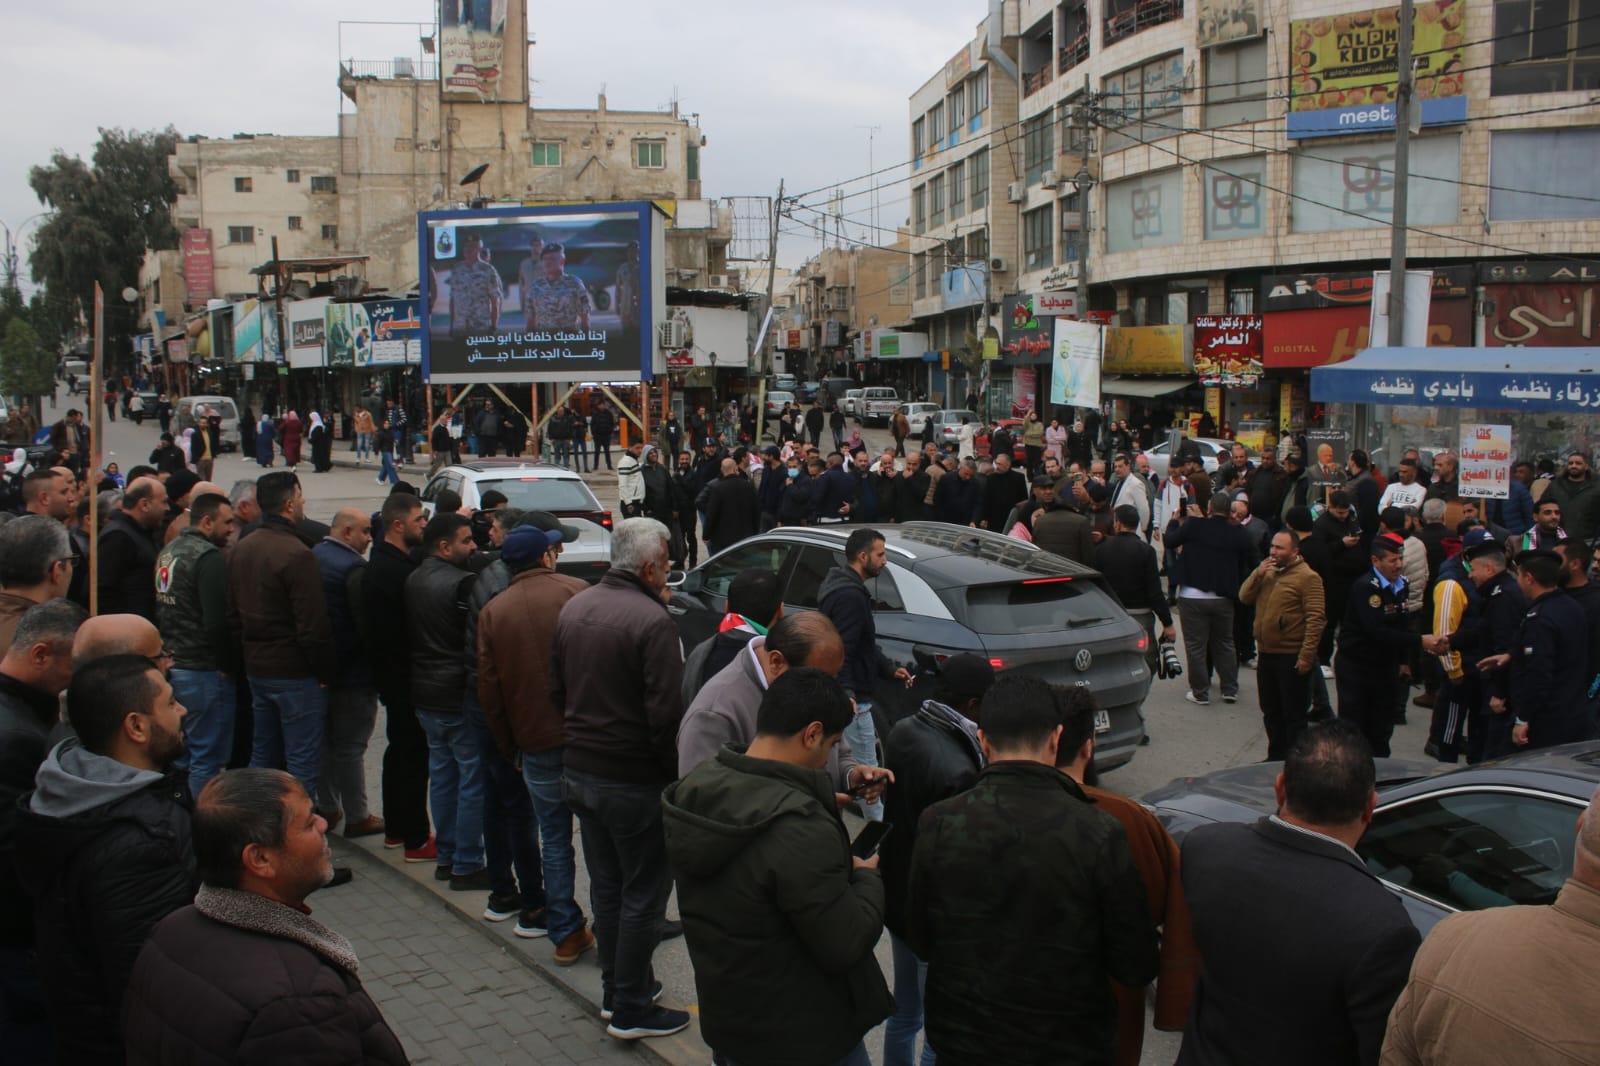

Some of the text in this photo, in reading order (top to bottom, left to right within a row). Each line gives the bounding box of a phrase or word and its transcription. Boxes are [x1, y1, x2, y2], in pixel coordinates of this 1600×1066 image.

[1337, 25, 1414, 49] ALPH
[1340, 43, 1398, 62] KIDZ
[1340, 106, 1390, 124] meet
[372, 304, 394, 317] معرض
[1041, 297, 1073, 310] صيدلية
[1196, 316, 1262, 330] برغر وكوكتيل سناكات
[466, 329, 606, 346] إحنا شعبك خلفك يا ابو حسين
[1208, 332, 1249, 348] العامر
[540, 348, 559, 361] الجد
[1271, 342, 1318, 353] DIGITAL
[1370, 376, 1415, 397] نظيفه
[1423, 374, 1474, 401] بأيدي
[1500, 379, 1551, 402] نظيفه
